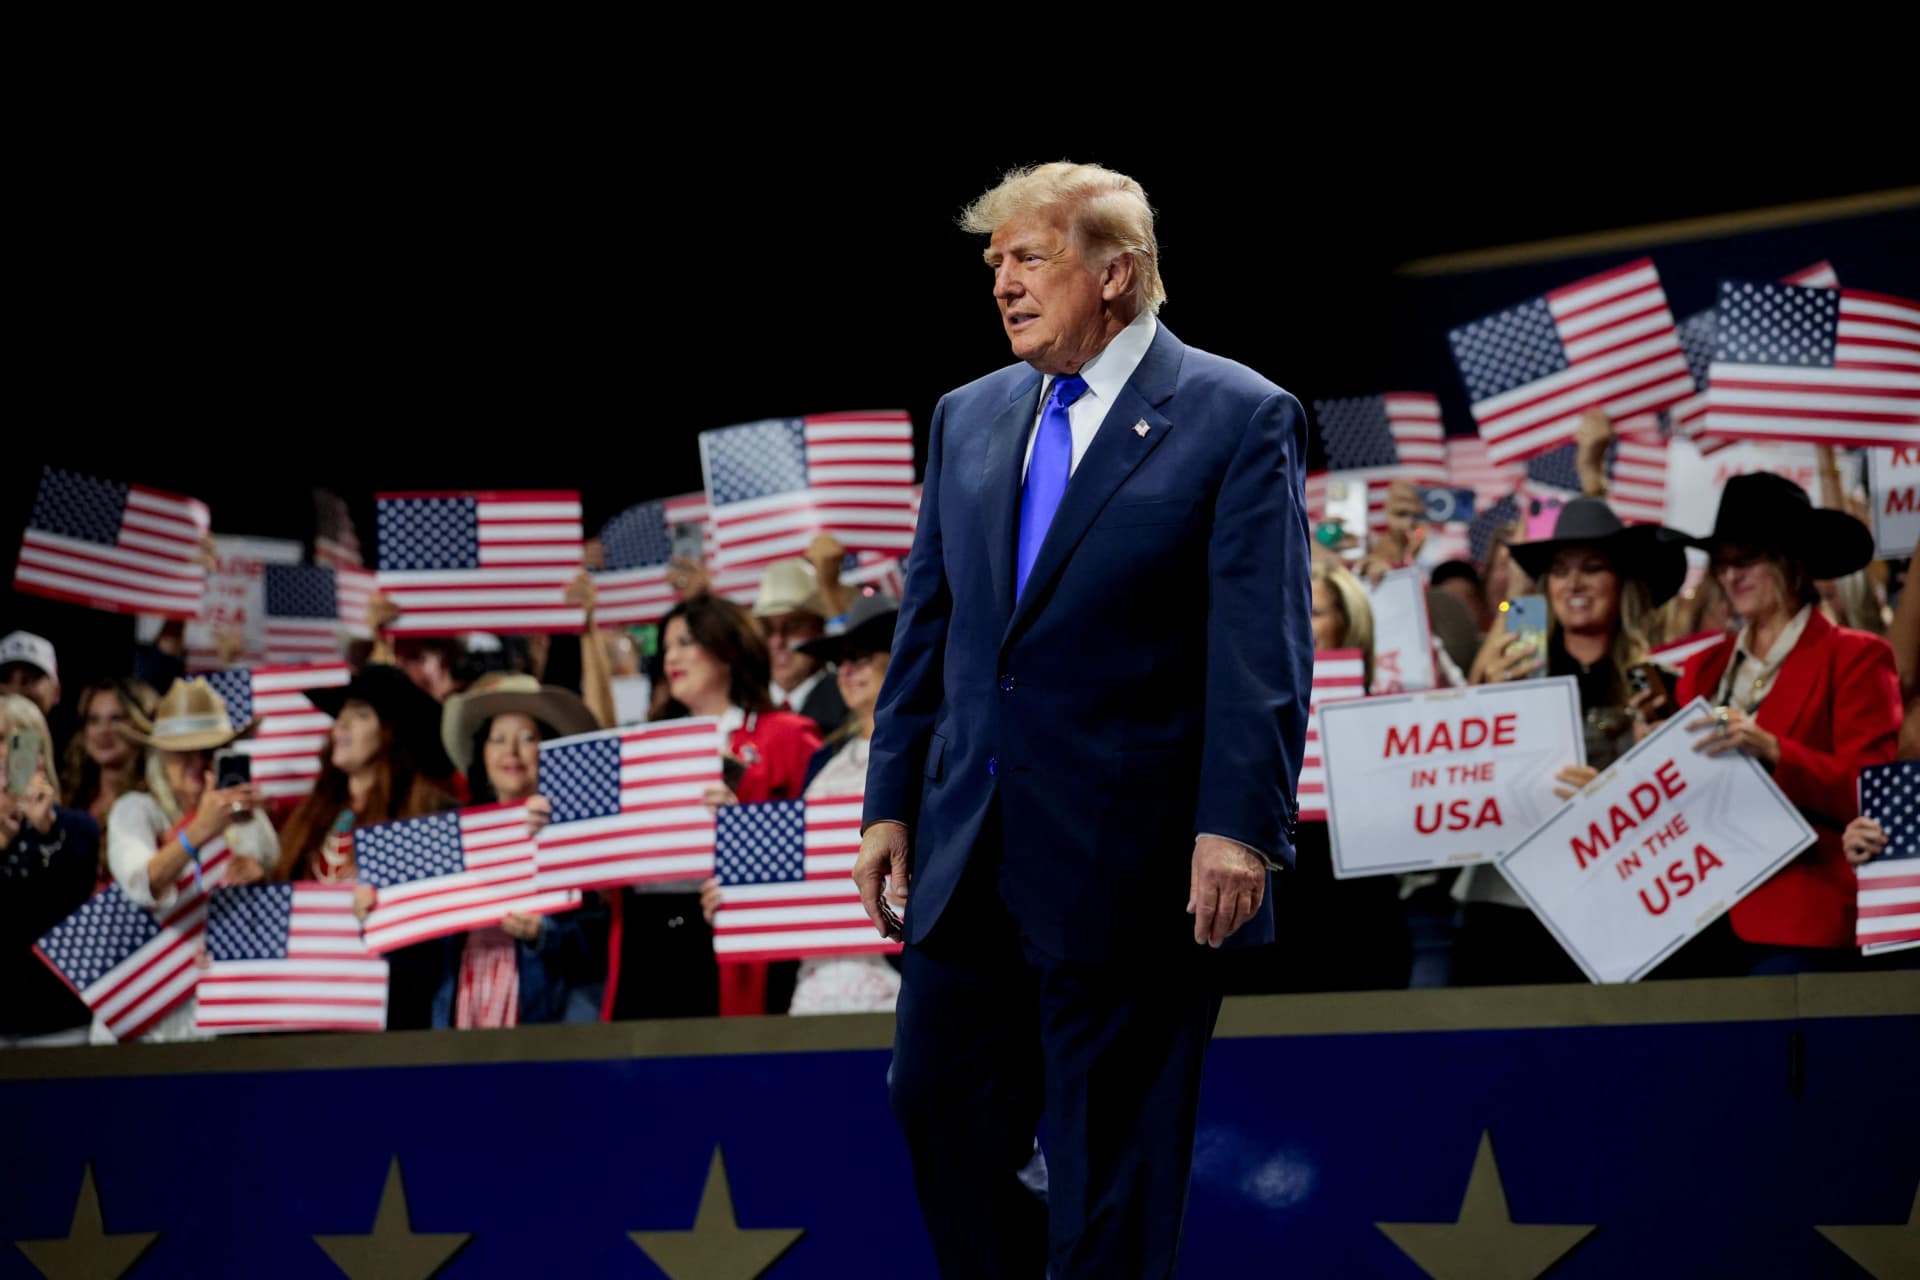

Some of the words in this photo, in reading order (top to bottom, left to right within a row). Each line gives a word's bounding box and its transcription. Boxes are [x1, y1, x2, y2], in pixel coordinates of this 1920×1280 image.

[1885, 487, 1920, 514] M
[1383, 713, 1518, 758] MADE
[1411, 769, 1438, 788] IN
[1446, 763, 1495, 783] THE
[1415, 796, 1504, 835] USA
[1568, 759, 1688, 867] MADE
[1615, 850, 1644, 879] IN
[1642, 813, 1688, 855] THE
[1638, 843, 1724, 917] USA
